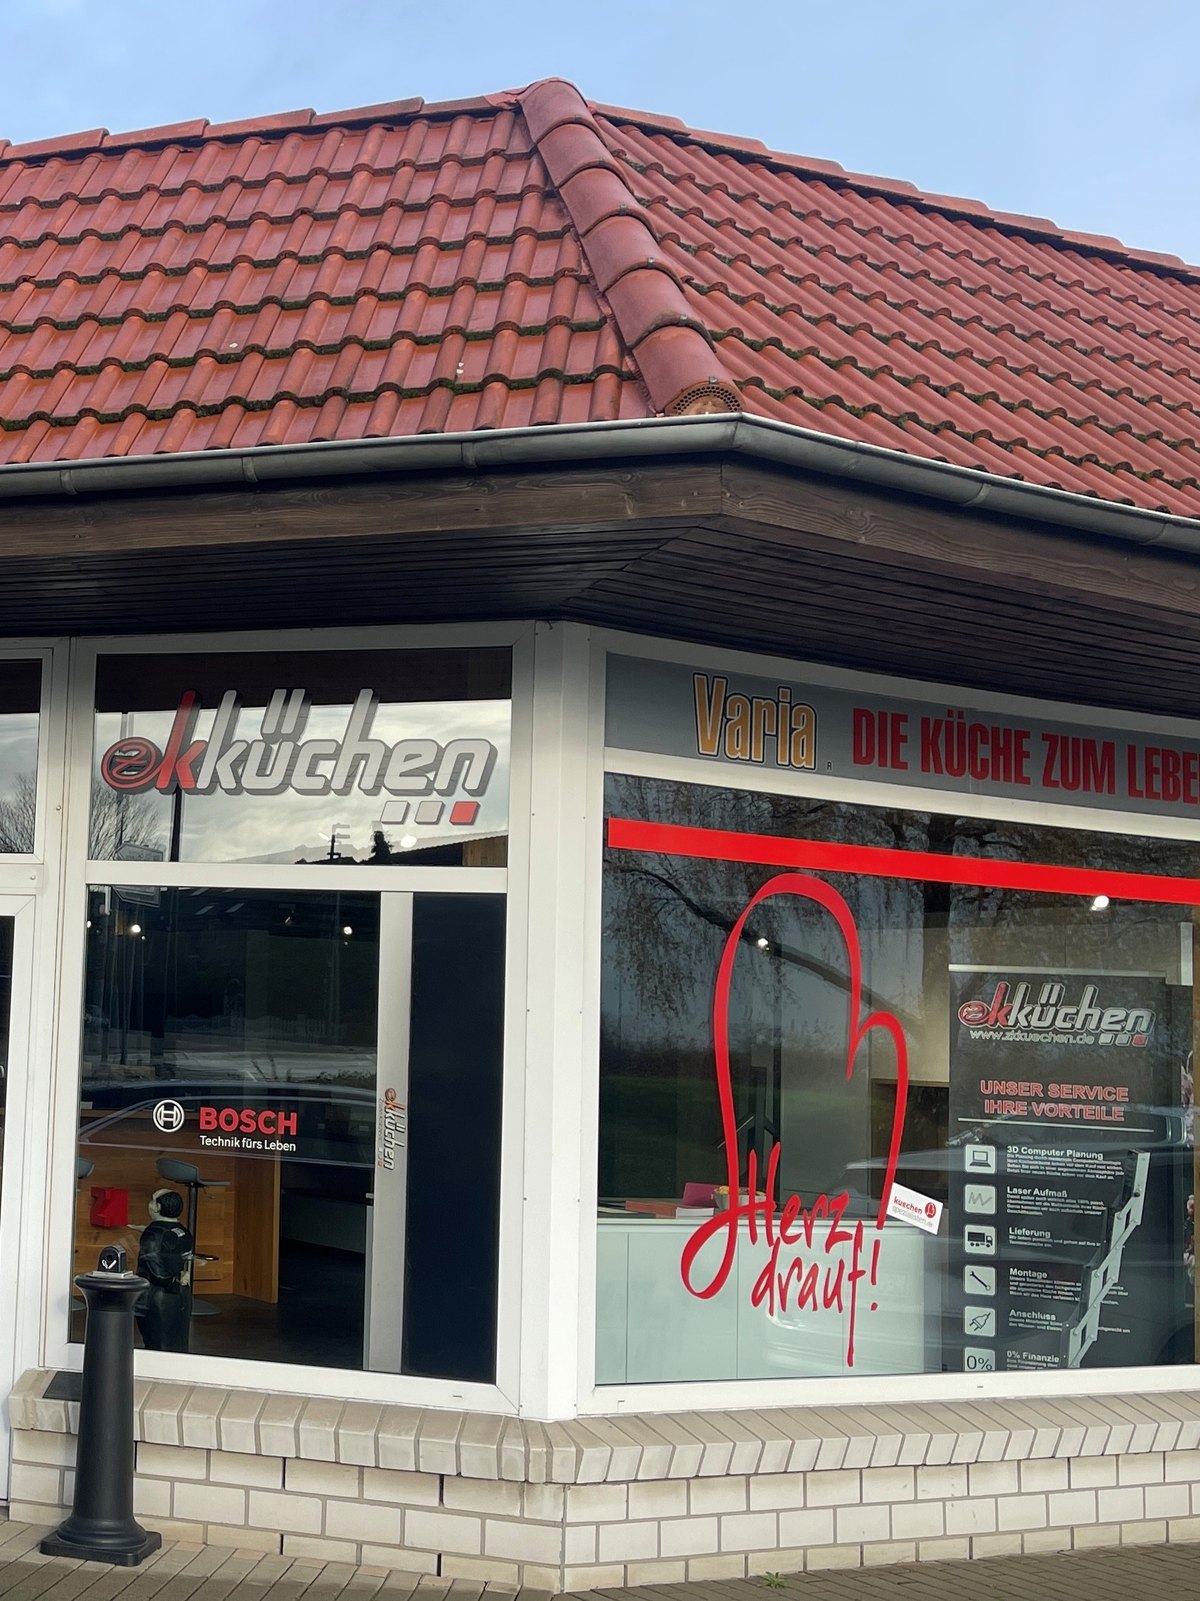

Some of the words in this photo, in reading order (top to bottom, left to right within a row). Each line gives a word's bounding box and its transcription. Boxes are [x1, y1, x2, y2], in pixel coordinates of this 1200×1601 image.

[693, 672, 818, 771] Varia
[853, 708, 908, 771] DIE
[921, 709, 1031, 785] KÜCHE
[1041, 732, 1115, 795] ZUM
[1127, 744, 1200, 805] LEBE
[980, 1080, 1044, 1097] UNSER
[1048, 1083, 1129, 1102] SERVICE
[984, 1100, 1028, 1116] IHRE
[1032, 1103, 1126, 1122] VORTEILE
[199, 1106, 298, 1136] BOSCH
[200, 1135, 241, 1149] Technik
[242, 1137, 263, 1150] fürs
[264, 1139, 297, 1152] Leben
[1007, 1145, 1019, 1154] 3D
[1020, 1146, 1064, 1157] Computer
[1066, 1149, 1104, 1161] Planung
[1006, 1186, 1032, 1195] Laser
[1033, 1187, 1068, 1198] Aufmaß
[893, 1196, 923, 1215] kuechen
[1009, 1227, 1051, 1239] Lieferung
[1009, 1267, 1048, 1279] Montage
[752, 1220, 881, 1367] drauf!
[1009, 1309, 1057, 1321] Anschluss
[966, 1355, 993, 1371] 0%
[1006, 1350, 1021, 1359] 0%
[1022, 1352, 1060, 1363] Finanzie
